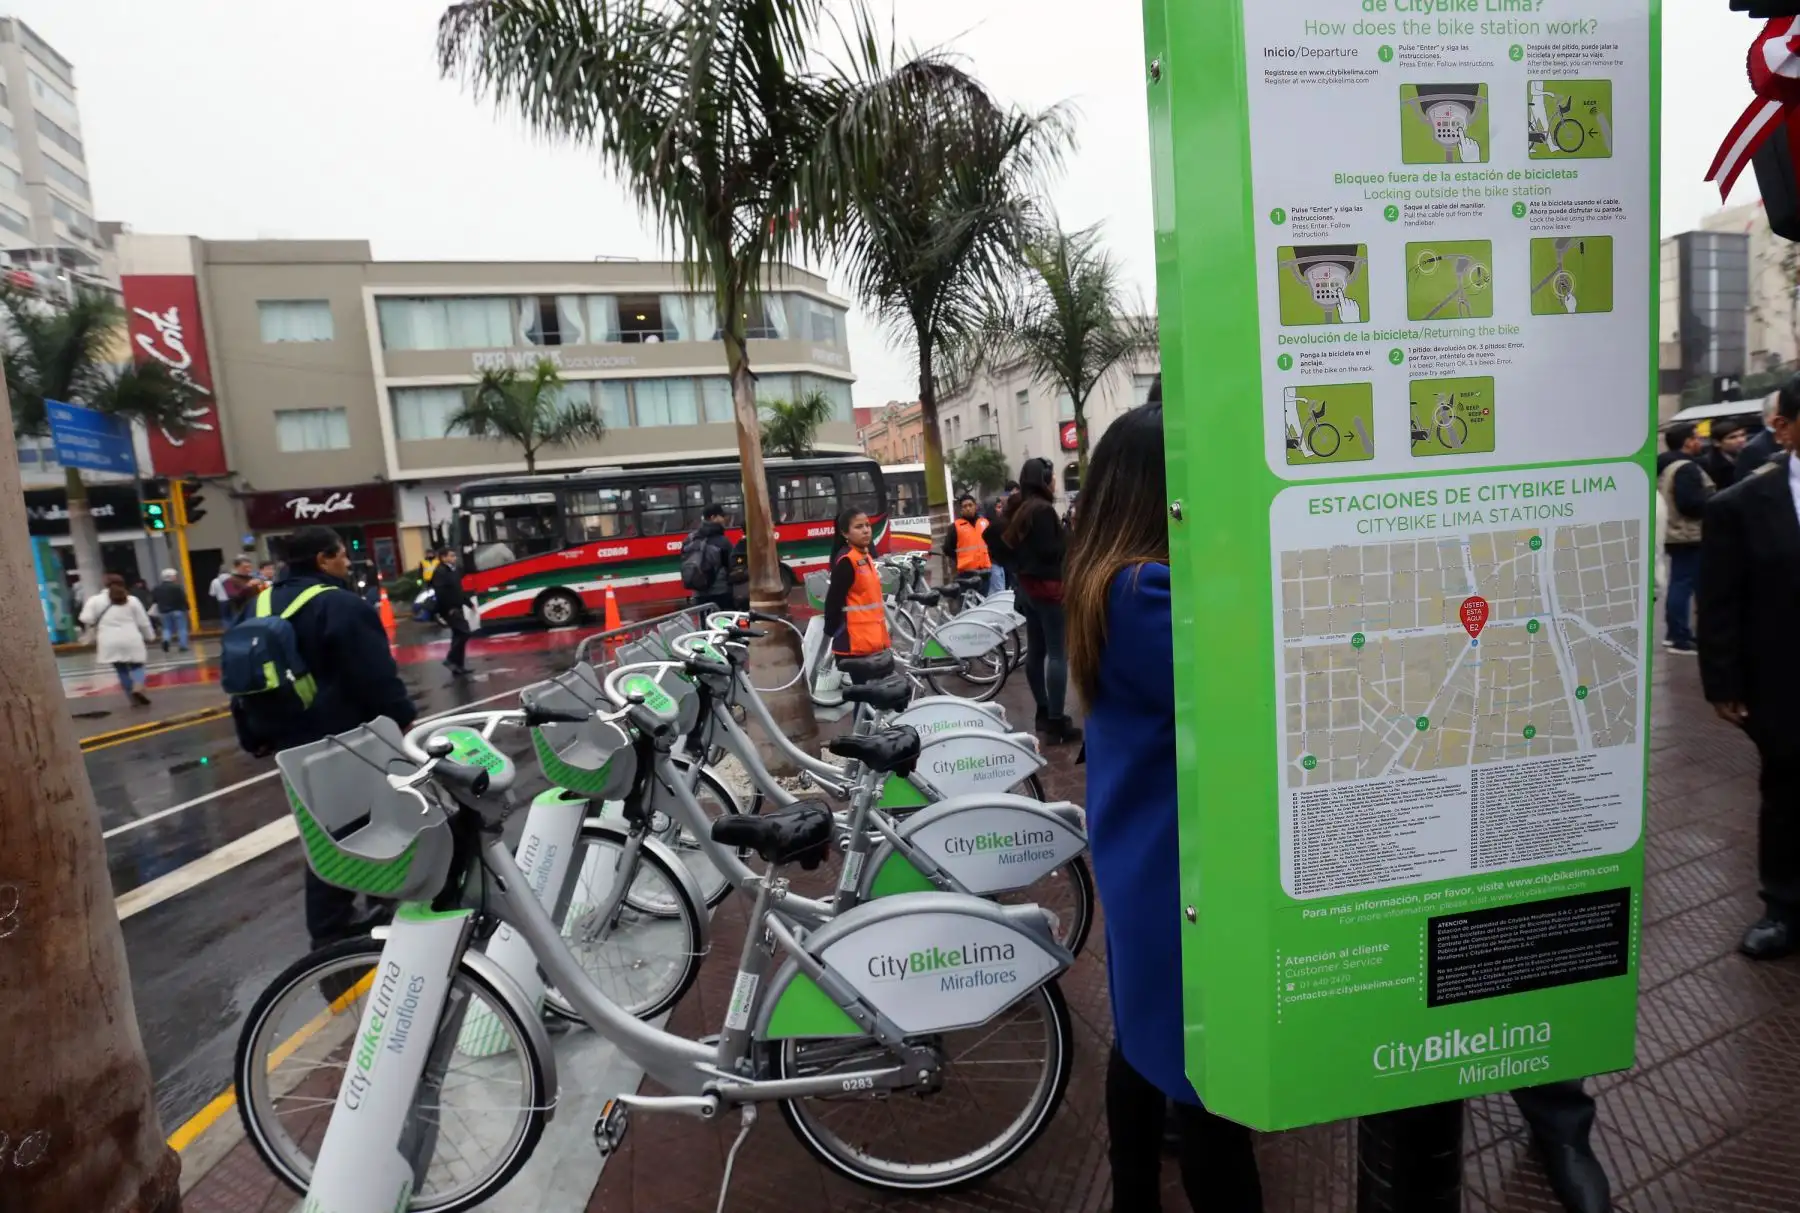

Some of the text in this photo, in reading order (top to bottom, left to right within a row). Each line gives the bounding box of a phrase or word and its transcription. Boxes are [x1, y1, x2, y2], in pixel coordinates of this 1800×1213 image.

[1362, 0, 1543, 16] de CityBike Lima?
[1305, 19, 1598, 36] How does the bike station work?
[1263, 46, 1358, 58] Inicio/Departure
[1334, 169, 1578, 186] Bloqueo fuera de la estación de bicicletas
[1364, 185, 1552, 200] Locking outside the bike station
[1278, 324, 1519, 345] Devolución de la bicicleta/Returning the bike
[1308, 474, 1617, 514] ESTACIONES DE CITYBIKE LIMA
[1357, 502, 1574, 534] CITYBIKE LIMA STATIONS
[808, 527, 835, 536] MIRAFLO
[597, 546, 628, 557] CEDROS
[933, 752, 1015, 775] CityBikeLima
[973, 768, 1016, 782] Miraflores
[944, 829, 1054, 855] CityBikeLima
[998, 850, 1054, 865] Miraflores
[1302, 865, 1620, 918] Para más información, por favor, visite www.citybikelima.com
[1340, 914, 1354, 924] For
[1357, 912, 1382, 922] more
[1438, 920, 1468, 928] ATENCION
[868, 942, 1015, 980] CityBikeLima
[1285, 945, 1390, 966] Atención al cliente
[1285, 959, 1383, 978] Customer Service
[940, 968, 1016, 992] Miraflores
[387, 974, 425, 1055] Miraflores
[344, 959, 401, 1112] CityBikeLima
[1373, 1022, 1551, 1072] CityBikeLima
[1459, 1054, 1550, 1086] Miraflores
[842, 1077, 874, 1092] 0283
